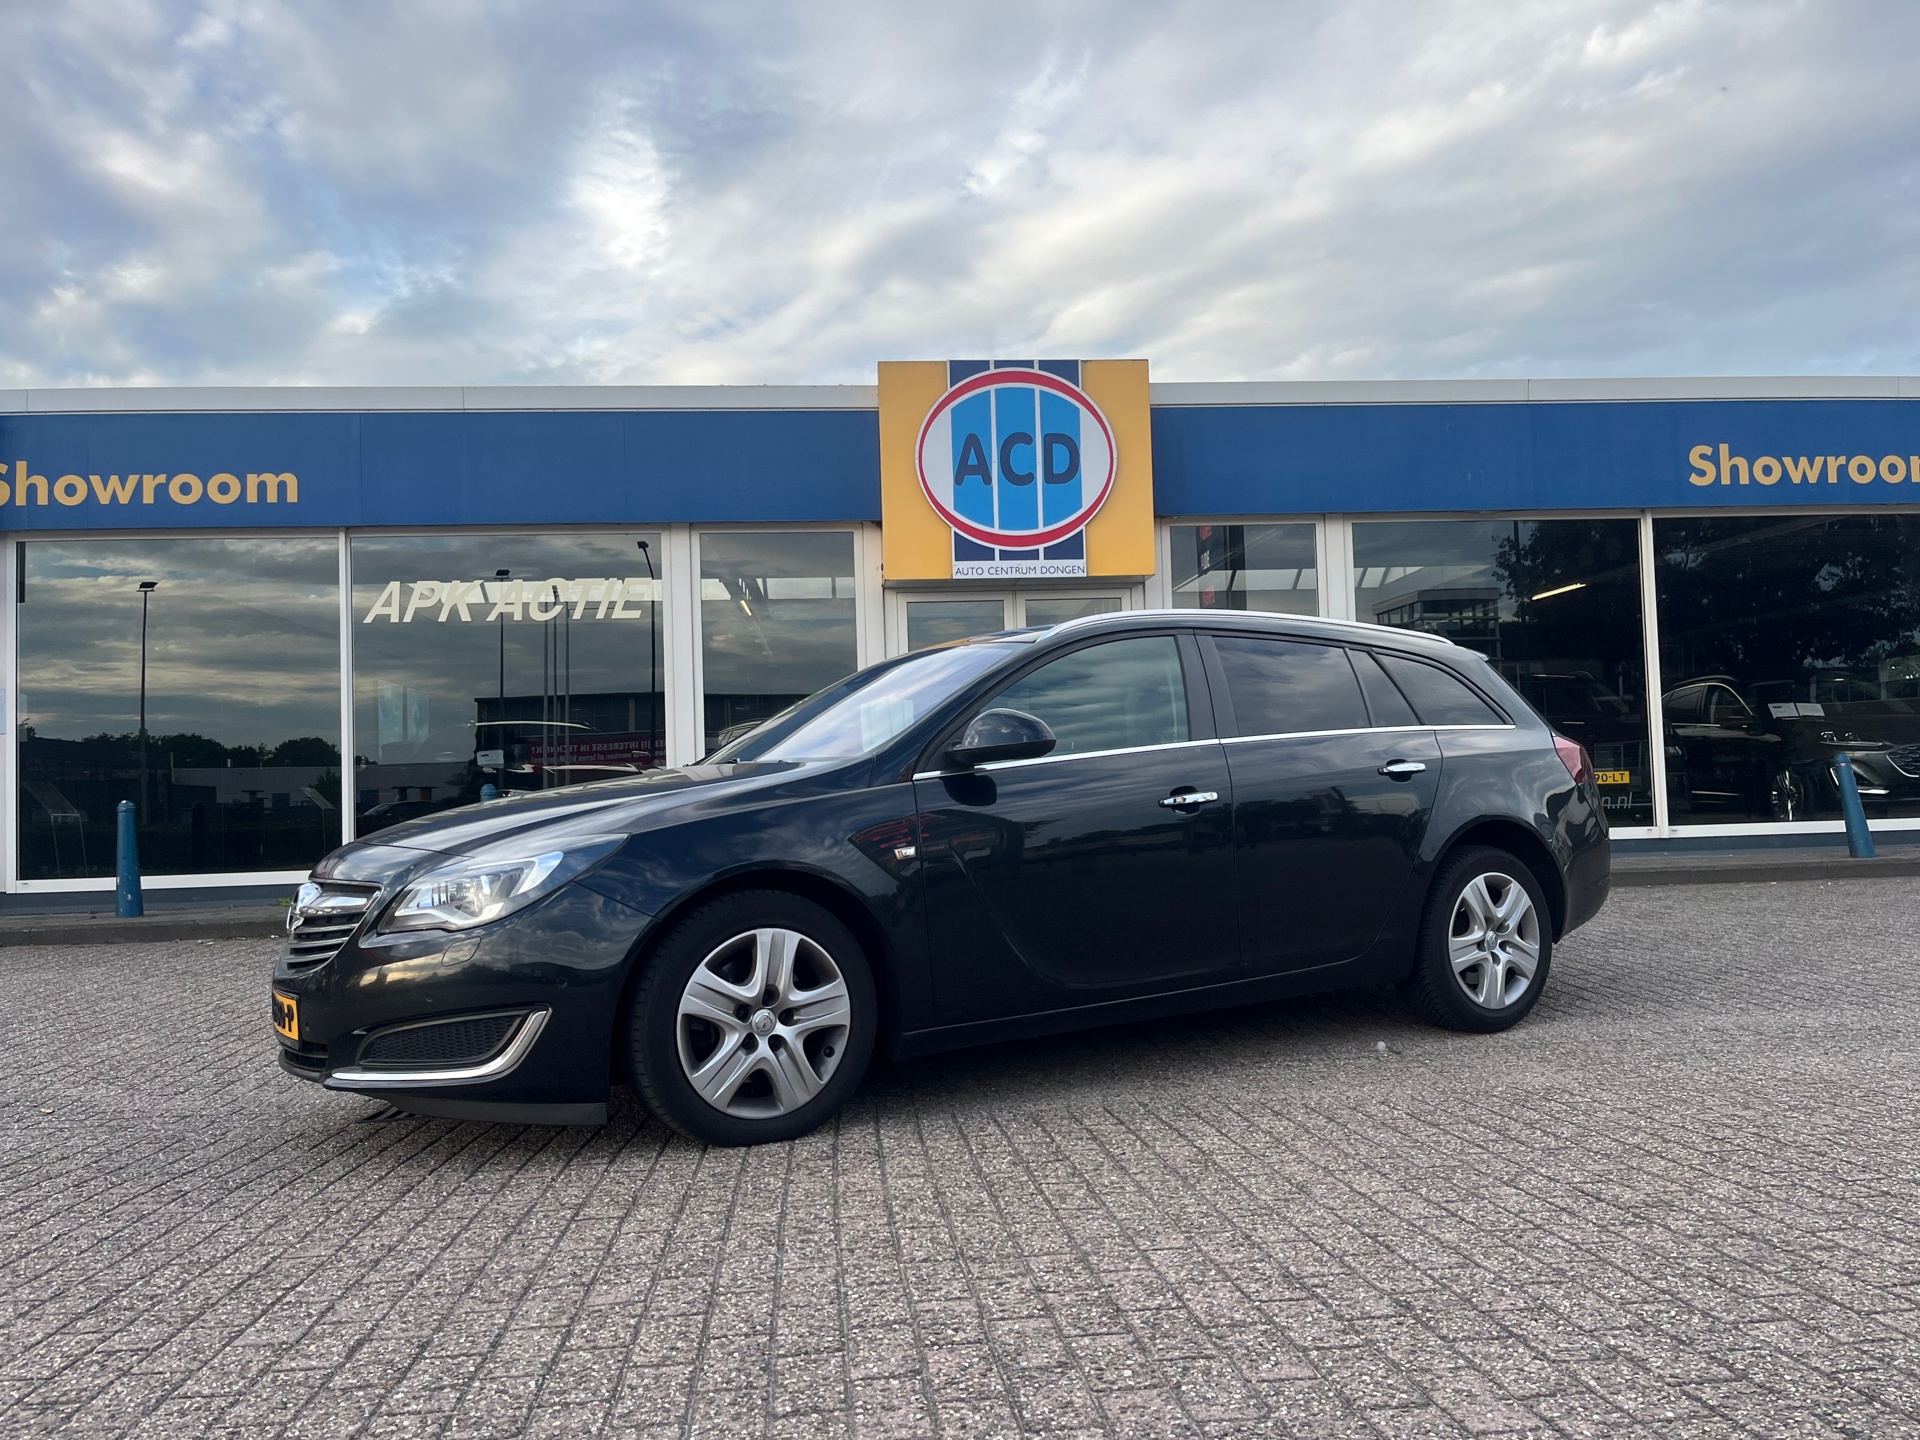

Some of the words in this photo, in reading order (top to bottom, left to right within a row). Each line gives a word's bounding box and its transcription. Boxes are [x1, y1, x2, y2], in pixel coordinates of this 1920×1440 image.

[955, 432, 1080, 486] ACD
[1688, 443, 1920, 487] Showroo
[955, 566, 985, 576] AUTO
[987, 565, 1037, 576] CENTRUM
[1040, 565, 1085, 575] DONGEN
[363, 579, 485, 623] APK
[486, 577, 654, 622] ACTIE
